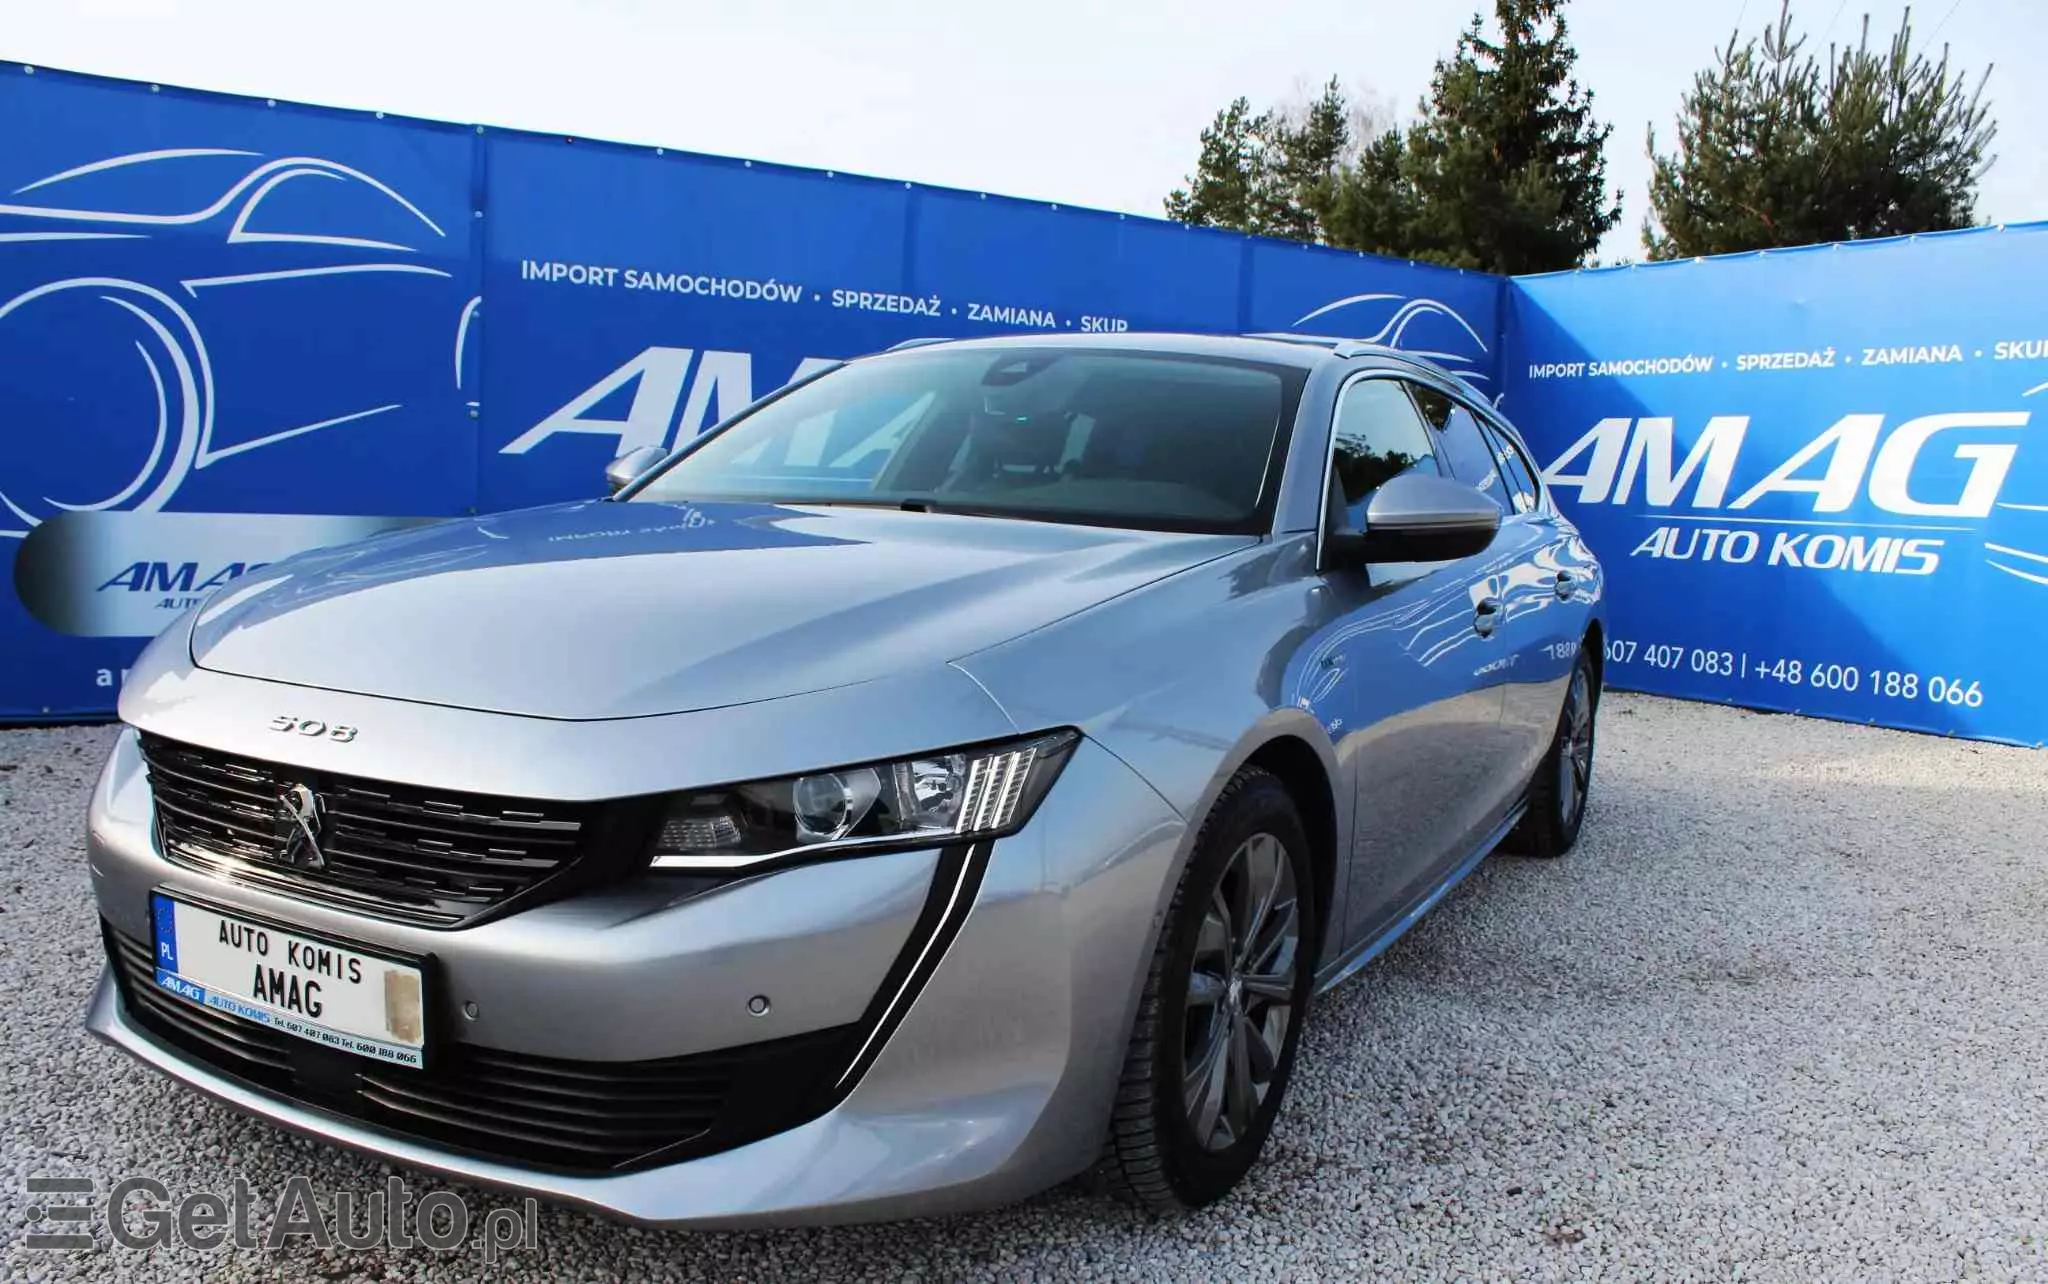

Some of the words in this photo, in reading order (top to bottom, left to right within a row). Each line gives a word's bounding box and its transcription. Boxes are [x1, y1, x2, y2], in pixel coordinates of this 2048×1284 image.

[521, 260, 619, 288] IMPORT
[624, 269, 802, 303] SAMOCHODÓW
[831, 289, 941, 317] SPRZEDAŻ
[968, 303, 1056, 328] ZAMIANA
[1529, 363, 1585, 379] IMPORT
[1588, 354, 1713, 377] SAMOCHODÓW
[1735, 347, 1836, 371] SPRZEDAŻ
[1861, 344, 1964, 366] ZAMIANA
[1630, 525, 1763, 563] AUTO
[1767, 531, 1945, 575] KOMIS
[96, 562, 272, 592] AMA
[1644, 644, 1684, 670] 407
[1691, 649, 1734, 676] 083
[1755, 659, 1802, 685] +48
[1810, 663, 1859, 692] 600
[1869, 670, 1919, 699] 188
[1928, 676, 1984, 708] 066
[268, 715, 359, 744] 508
[161, 942, 175, 961] PL
[219, 919, 269, 957] AUTO
[288, 940, 362, 984] KOMIS
[253, 963, 322, 1018] AMAG
[161, 976, 200, 1001] AMAG
[209, 995, 236, 1012] AUTO
[238, 1004, 271, 1023] KOMIS
[356, 1042, 377, 1054] 600
[379, 1047, 394, 1058] 188
[396, 1052, 417, 1064] 066
